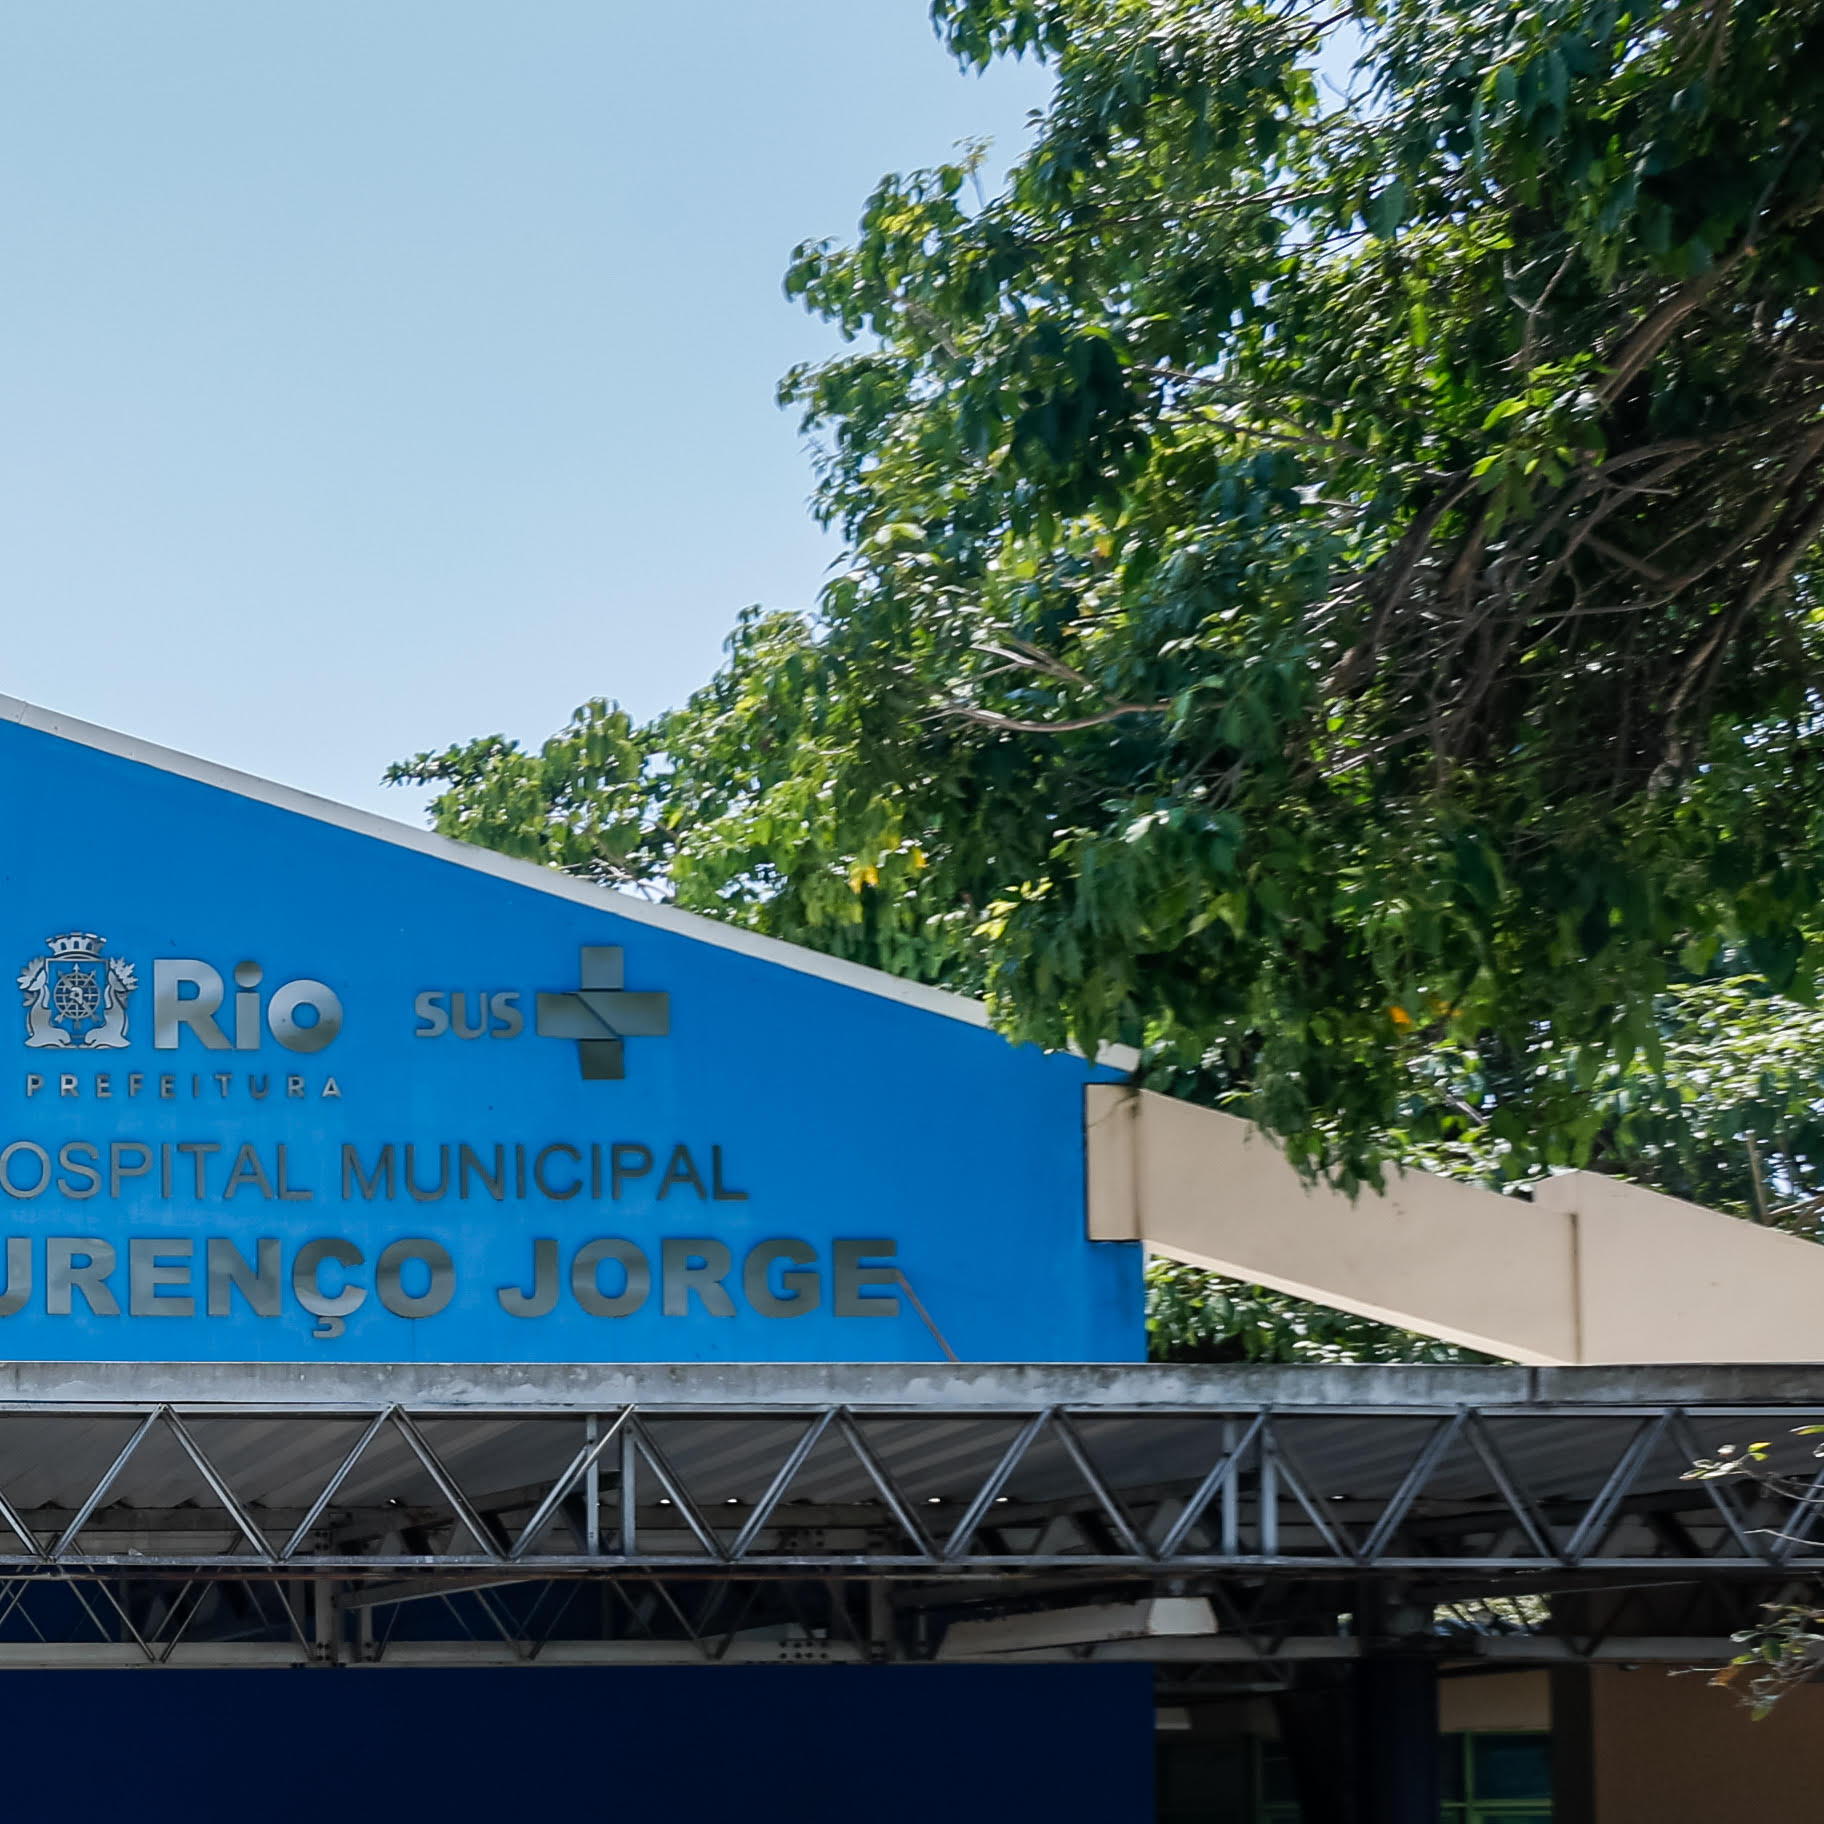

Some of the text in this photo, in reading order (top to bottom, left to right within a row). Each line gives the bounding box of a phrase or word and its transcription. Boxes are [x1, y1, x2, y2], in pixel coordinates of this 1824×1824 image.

[152, 959, 343, 1053] Rio
[414, 991, 521, 1039] SUS
[26, 1073, 342, 1099] PREFEITURA
[341, 1142, 750, 1201] MUNICIPAL
[498, 1237, 899, 1319] JORGE
